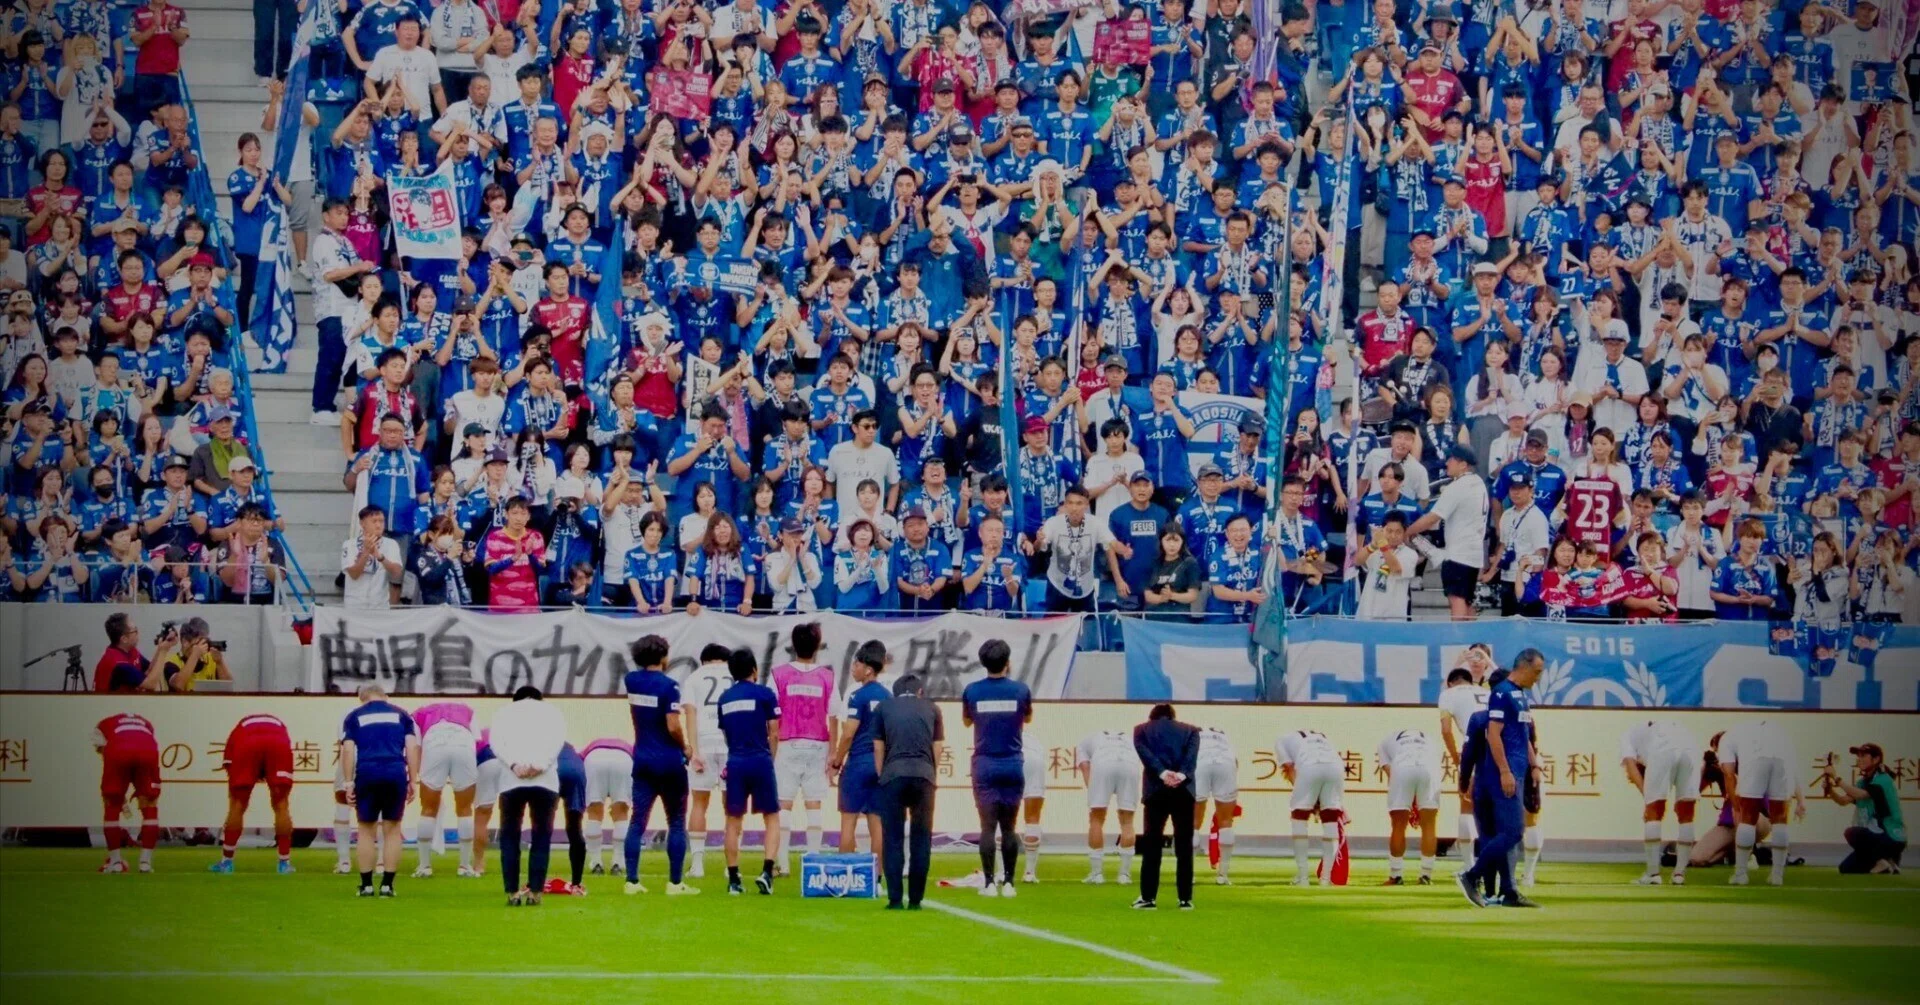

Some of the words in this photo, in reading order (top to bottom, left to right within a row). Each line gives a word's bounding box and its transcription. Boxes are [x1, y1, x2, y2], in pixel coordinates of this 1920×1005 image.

[1562, 276, 1576, 294] 27
[1575, 493, 1610, 529] 23
[1132, 522, 1154, 532] FEUS
[1565, 636, 1635, 656] 2016
